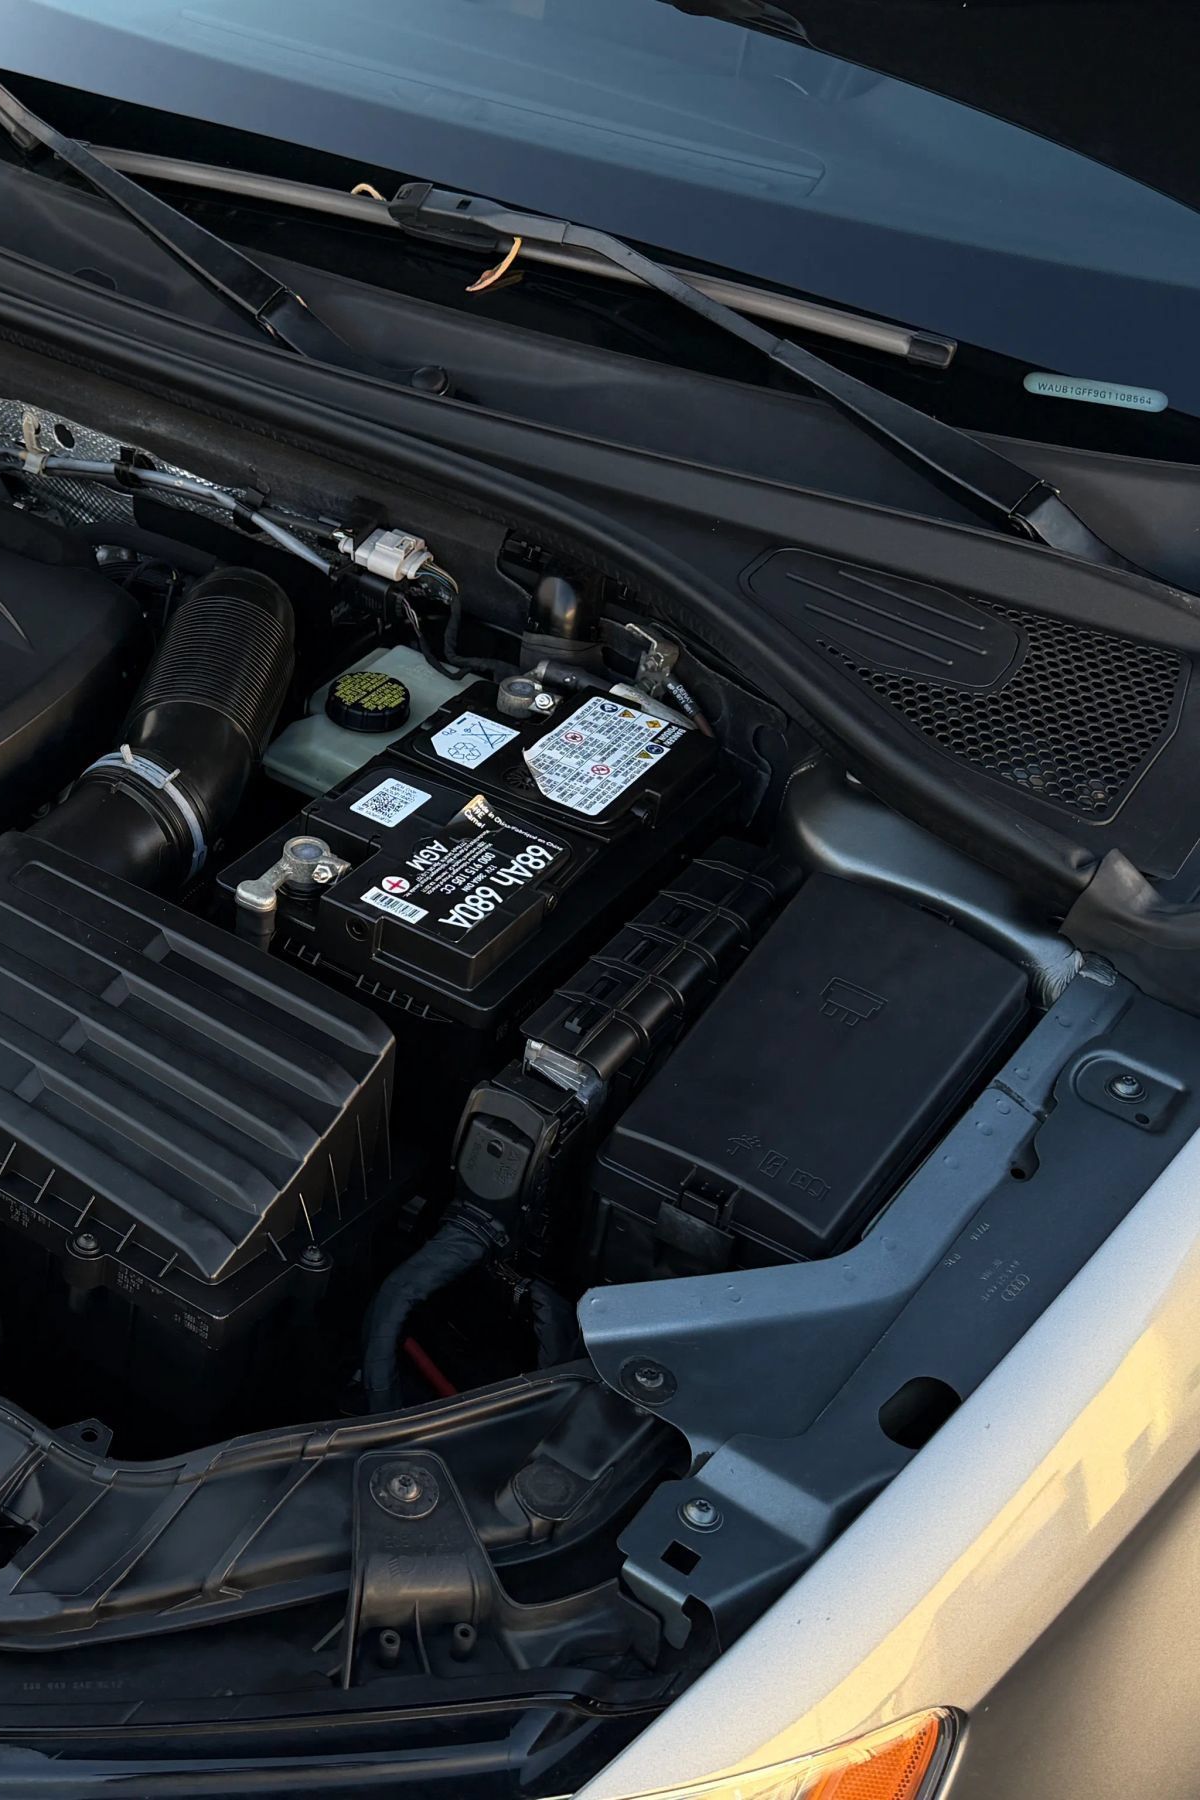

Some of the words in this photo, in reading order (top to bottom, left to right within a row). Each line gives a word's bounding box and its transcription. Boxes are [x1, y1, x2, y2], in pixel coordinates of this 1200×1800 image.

[406, 840, 448, 871] AGM
[490, 845, 554, 887] 68Ah
[449, 871, 469, 886] 105
[463, 861, 483, 875] 915
[438, 882, 456, 895] CC
[438, 886, 504, 929] 680A
